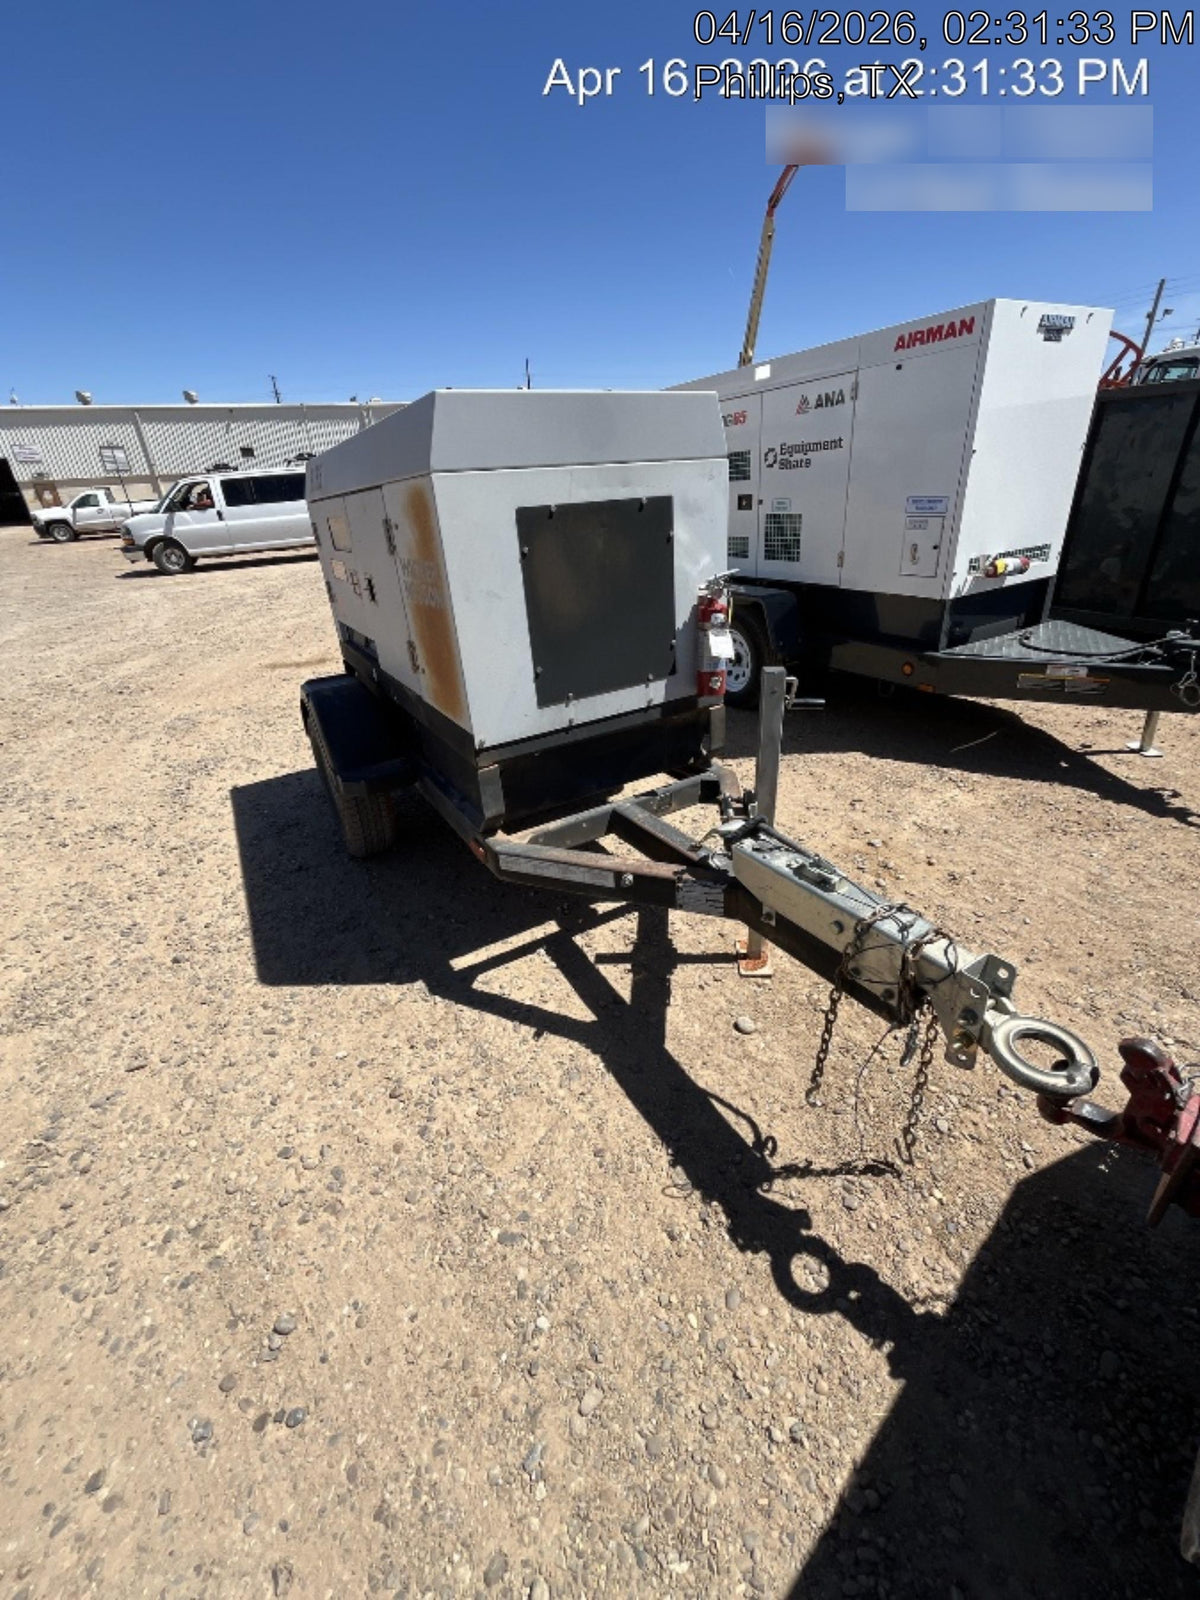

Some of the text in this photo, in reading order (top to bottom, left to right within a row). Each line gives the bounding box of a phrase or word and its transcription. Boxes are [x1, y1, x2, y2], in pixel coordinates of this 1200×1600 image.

[894, 316, 976, 352] AIRMAN
[814, 389, 846, 410] ANA
[779, 437, 844, 457] Equipment
[778, 458, 812, 470] Share
